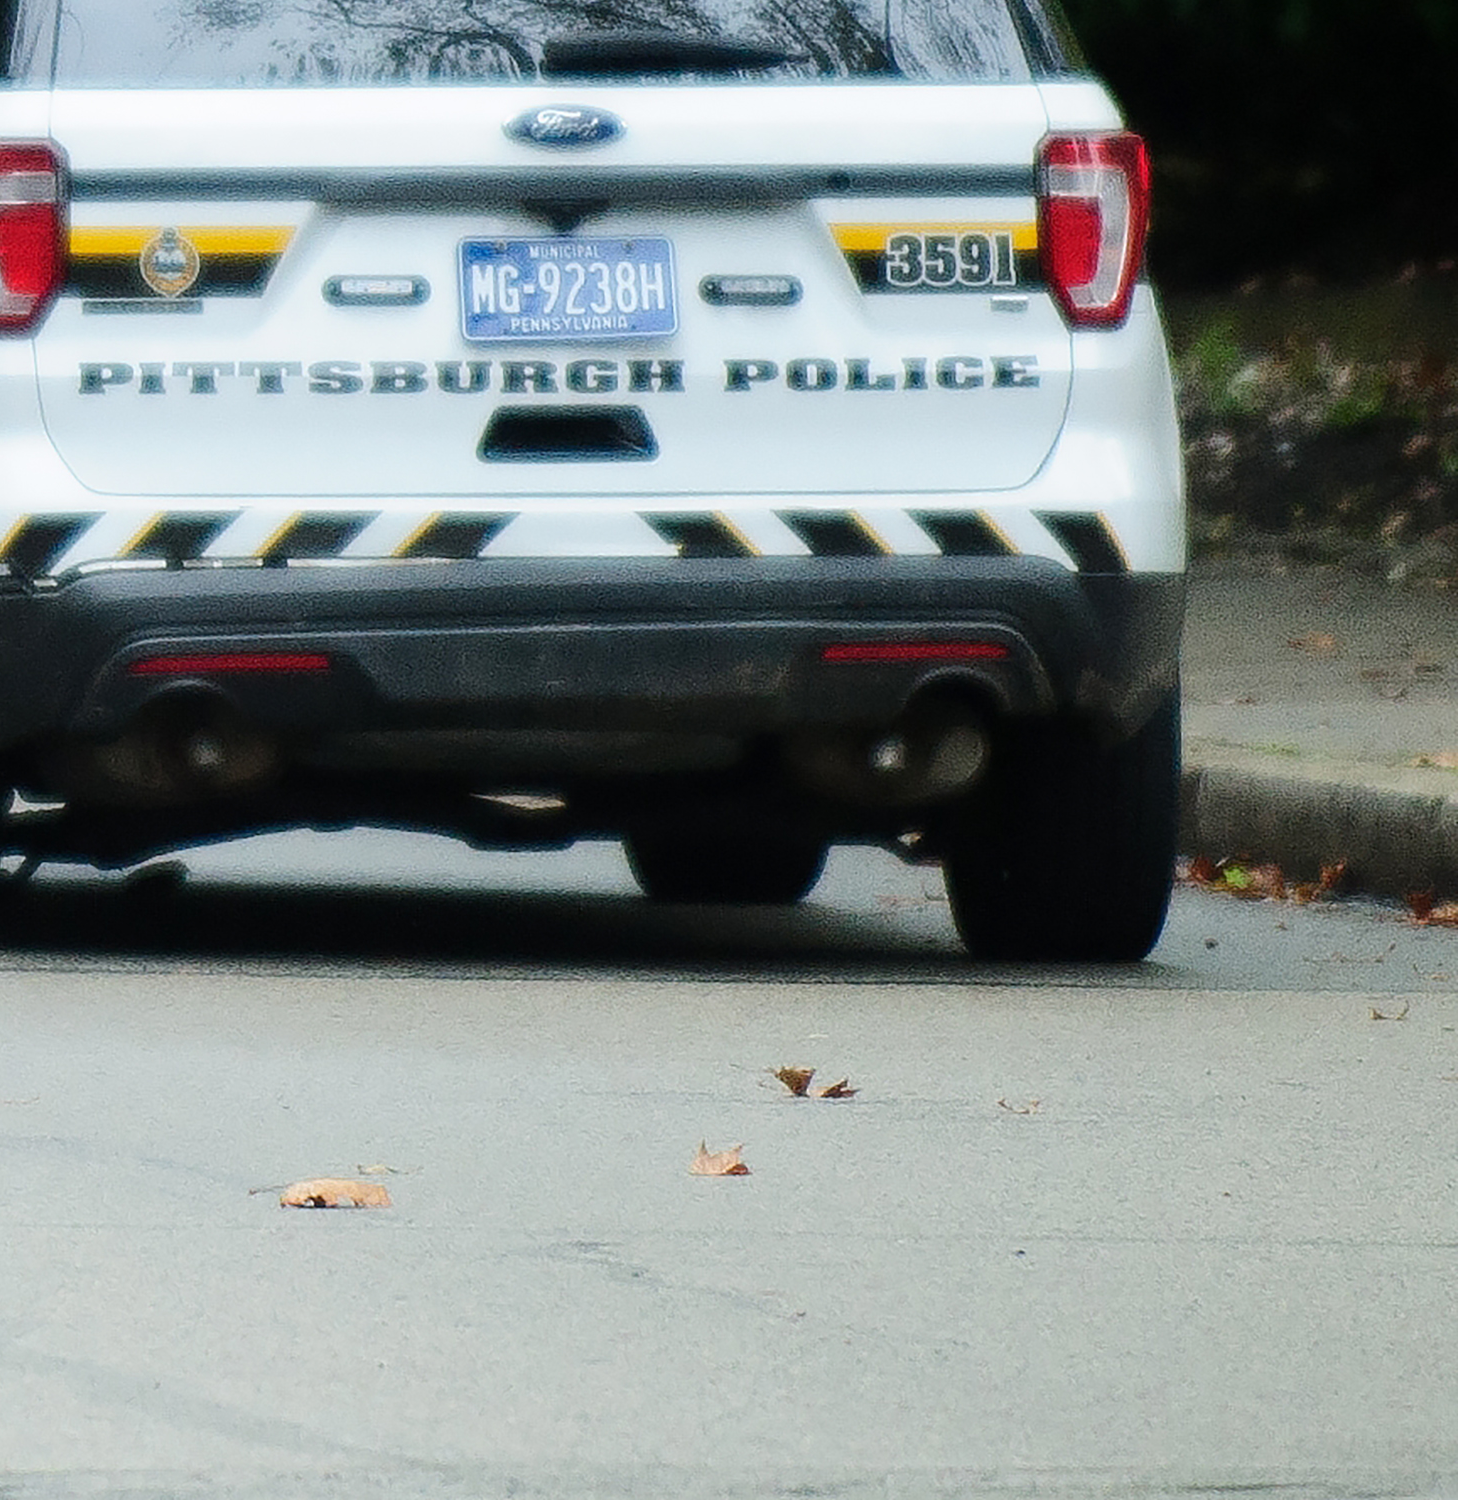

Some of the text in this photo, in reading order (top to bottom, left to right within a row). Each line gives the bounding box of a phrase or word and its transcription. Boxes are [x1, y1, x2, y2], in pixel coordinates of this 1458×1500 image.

[532, 109, 600, 142] Ford
[529, 245, 601, 259] MUNICIPAL
[887, 232, 1017, 287] 3591
[471, 261, 666, 315] MG-9238H
[510, 315, 629, 332] PENNSYLVANIA
[78, 354, 1041, 395] PITTSBURGH POLICE
